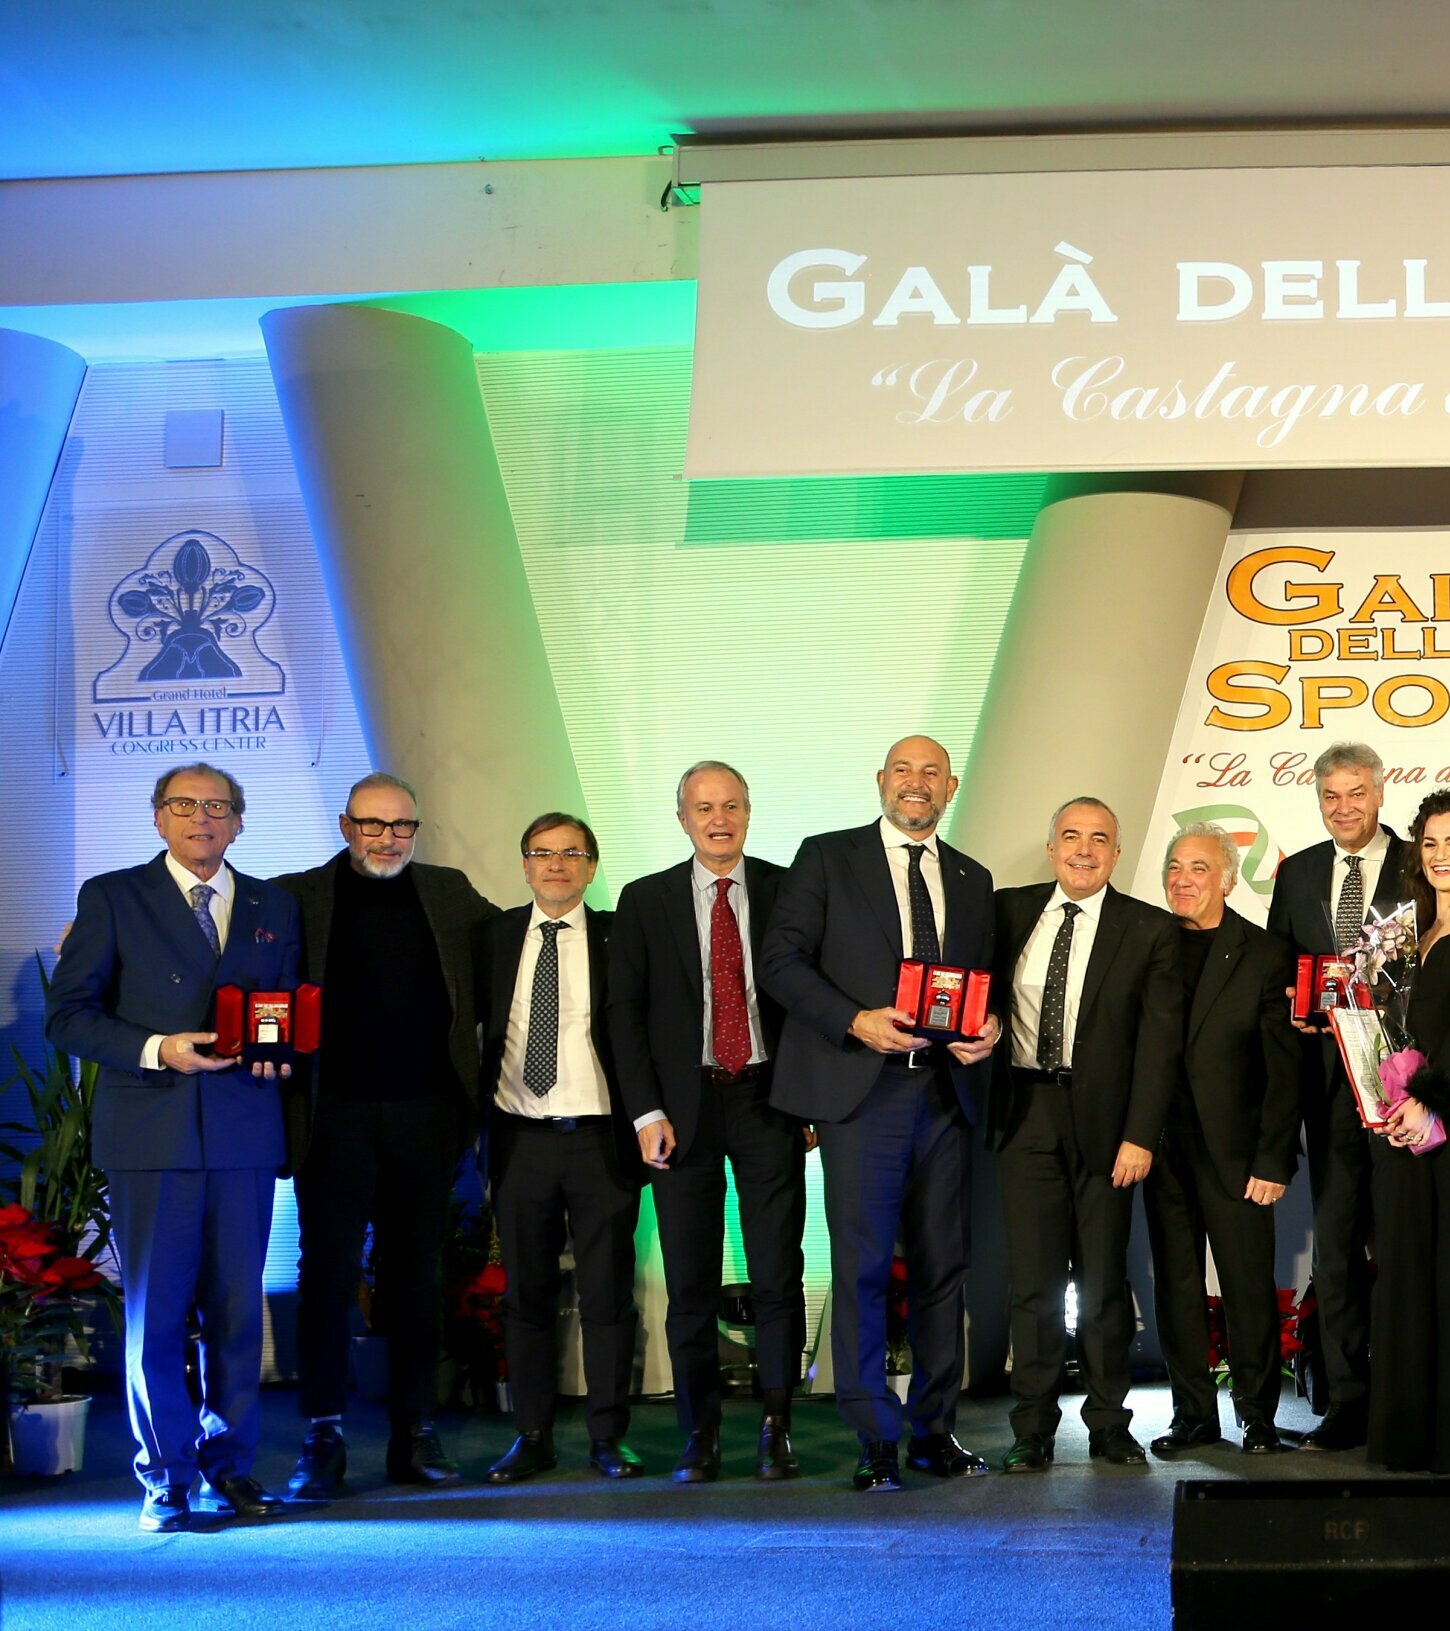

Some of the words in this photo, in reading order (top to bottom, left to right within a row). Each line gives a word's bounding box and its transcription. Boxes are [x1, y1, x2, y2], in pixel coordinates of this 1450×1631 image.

[766, 241, 1119, 329] GALÀ
[1050, 356, 1427, 449] Castagna
[153, 688, 190, 701] Grand
[193, 687, 227, 700] Hotel
[94, 709, 187, 738] VILLA
[199, 705, 286, 734] ITRIA
[111, 738, 199, 756] CONGRESS
[202, 736, 267, 751] CENTER
[1270, 751, 1427, 787] Cana
[1325, 1521, 1367, 1540] RCF
